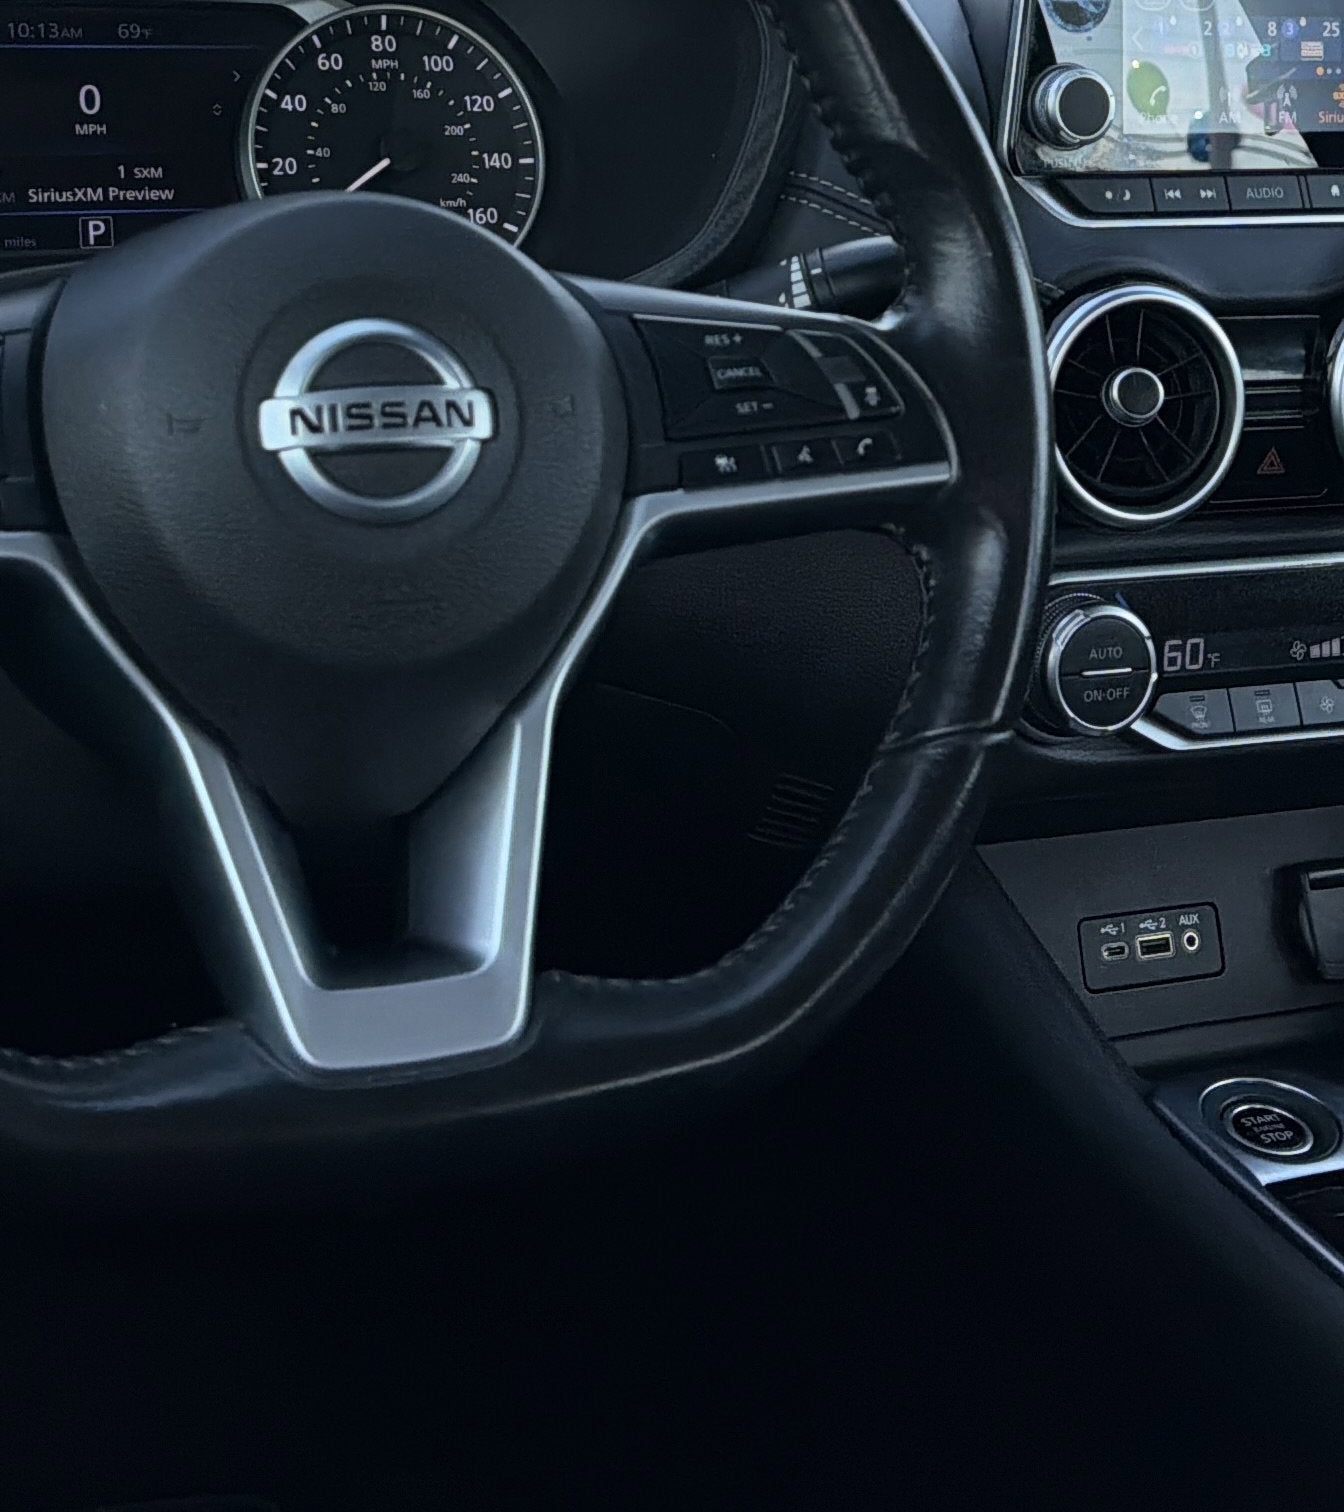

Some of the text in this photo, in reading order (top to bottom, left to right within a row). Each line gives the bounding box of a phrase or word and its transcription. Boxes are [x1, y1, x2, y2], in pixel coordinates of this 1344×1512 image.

[1204, 21, 1212, 36] 2
[1267, 21, 1277, 37] 8
[1322, 22, 1340, 37] 25
[371, 35, 396, 52] 80
[317, 53, 343, 71] 60
[371, 59, 399, 70] MPH
[422, 55, 453, 72] 100
[368, 81, 387, 92] 120
[79, 84, 101, 115] 0
[412, 88, 431, 100] 160
[281, 94, 306, 112] 40
[330, 102, 346, 114] 80
[464, 94, 494, 112] 120
[1278, 111, 1297, 123] FM
[75, 123, 106, 135] MPH
[444, 124, 464, 136] 200
[315, 147, 331, 158] 40
[272, 157, 297, 175] 20
[482, 152, 512, 169] 140
[117, 165, 164, 179] 1 SXM
[451, 173, 470, 184] 240
[27, 186, 175, 204] SiriusXM Preview
[1246, 187, 1284, 199] AUDIO
[439, 197, 467, 208] km/h
[467, 207, 498, 225] 160
[88, 220, 105, 245] P
[4, 235, 37, 249] miles
[289, 399, 474, 436] NISSAN
[1088, 646, 1123, 660] AUTO
[1179, 913, 1200, 925] AUX
[1241, 1114, 1281, 1127] START
[1260, 1130, 1294, 1144] STOP
